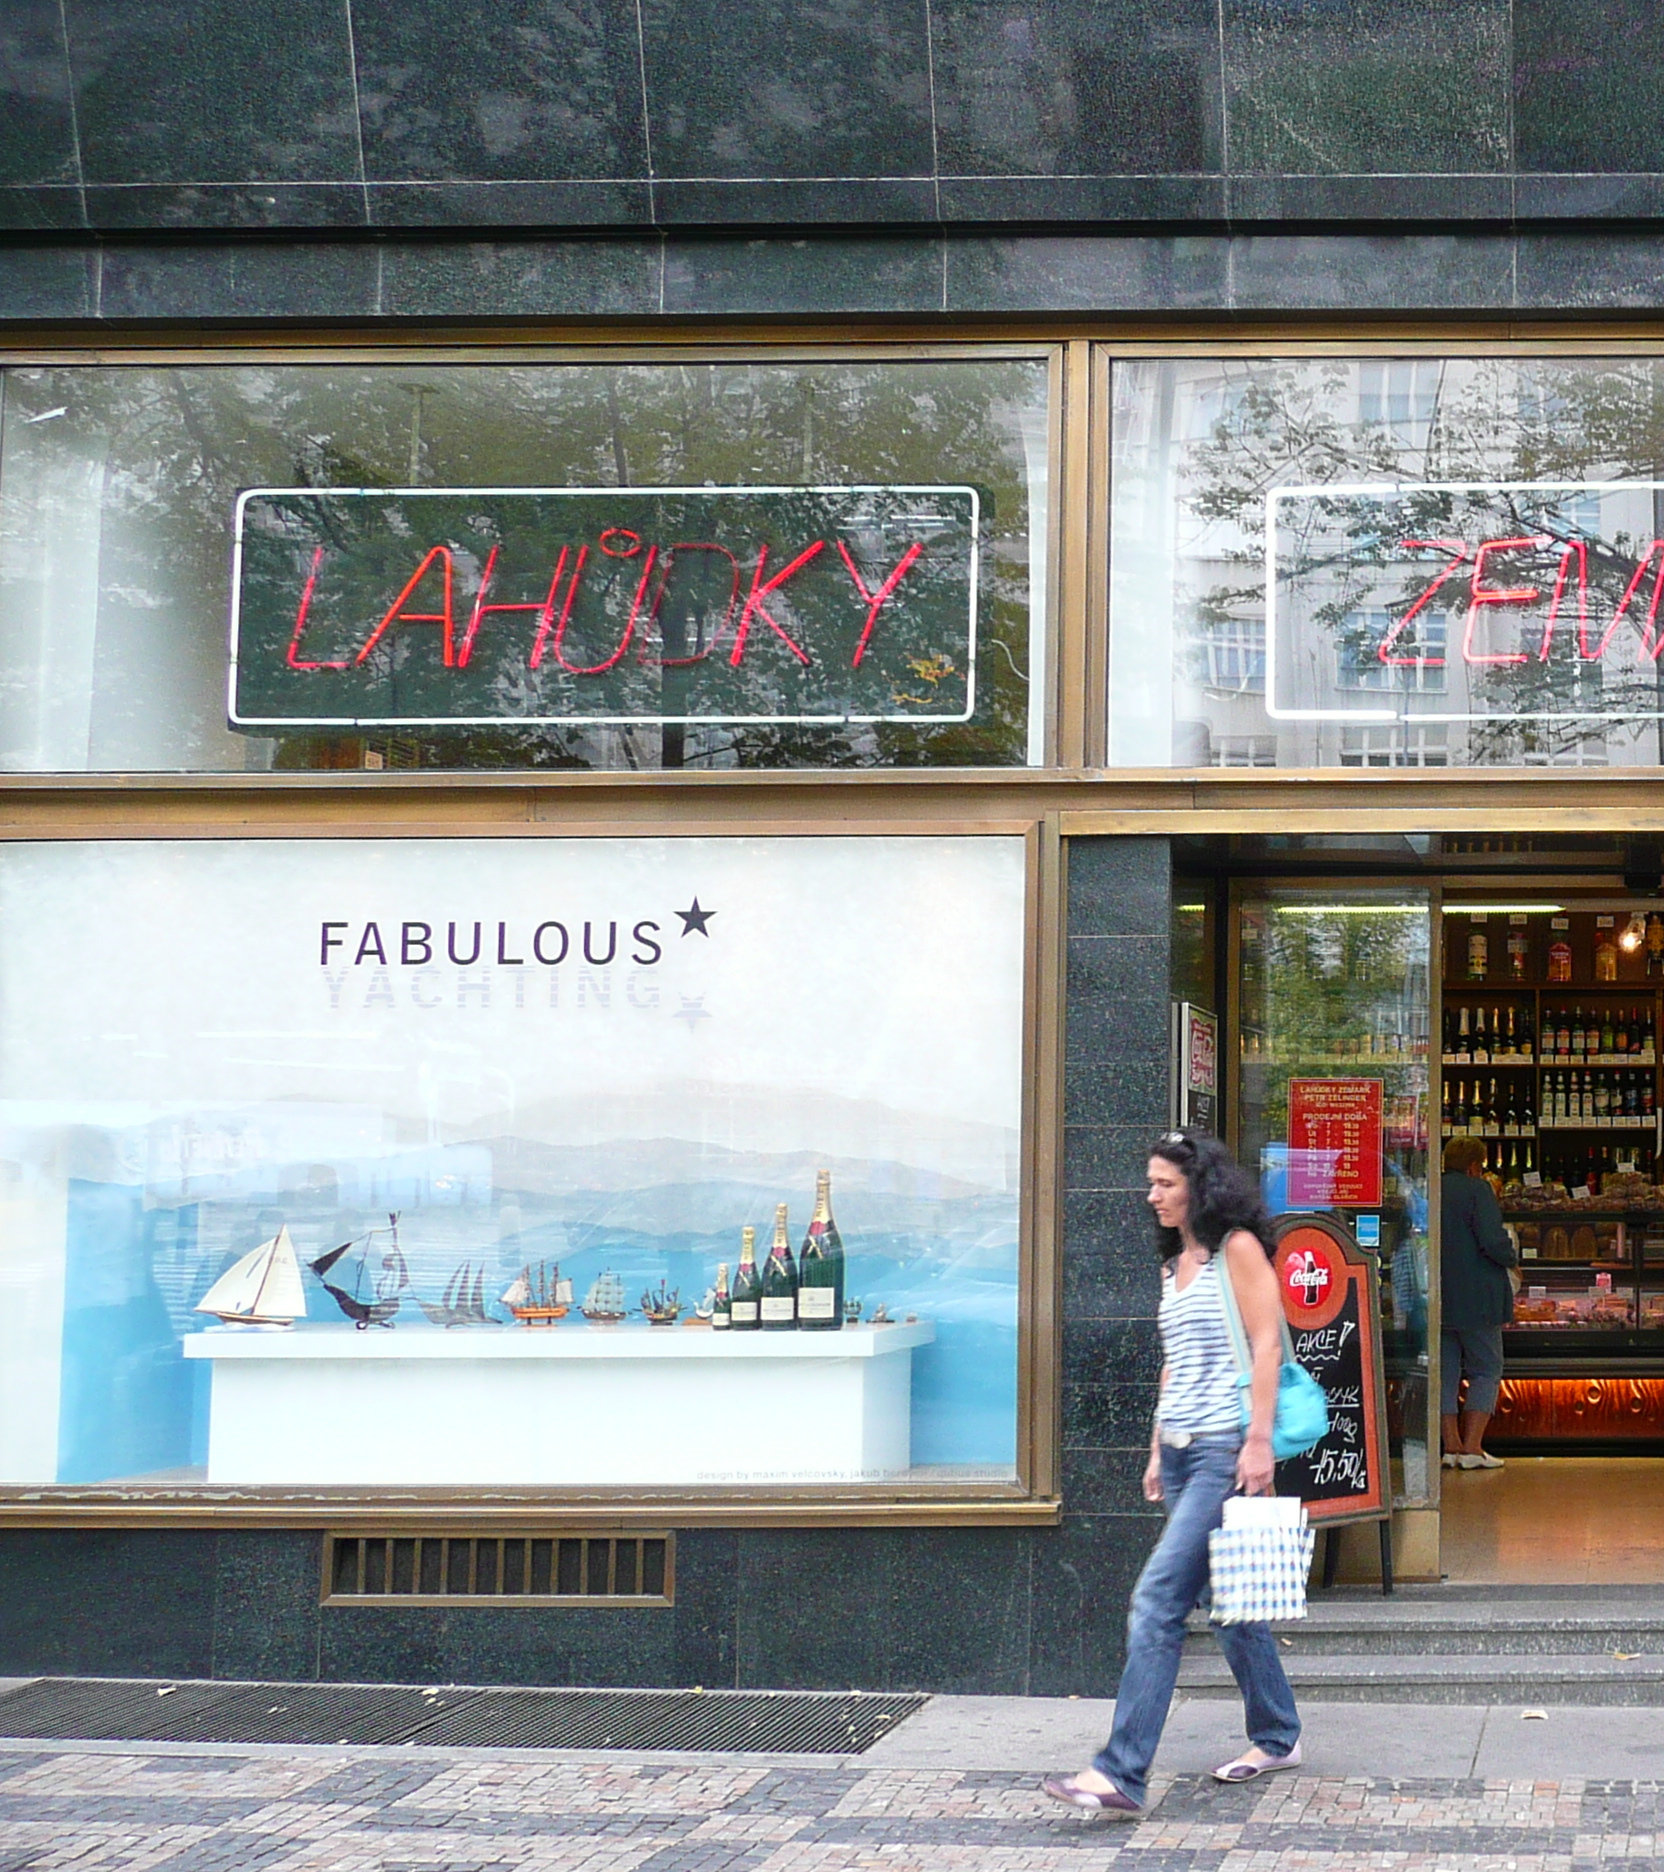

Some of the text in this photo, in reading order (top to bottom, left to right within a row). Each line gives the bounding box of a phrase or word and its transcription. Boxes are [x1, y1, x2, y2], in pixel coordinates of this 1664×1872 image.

[287, 527, 925, 675] LAHŮDKY
[320, 920, 662, 966] FABULOUS
[320, 965, 660, 1009] YACHTING
[697, 1470, 733, 1480] design
[736, 1470, 749, 1480] by
[752, 1470, 788, 1479] maxim
[850, 1468, 880, 1479] jakub
